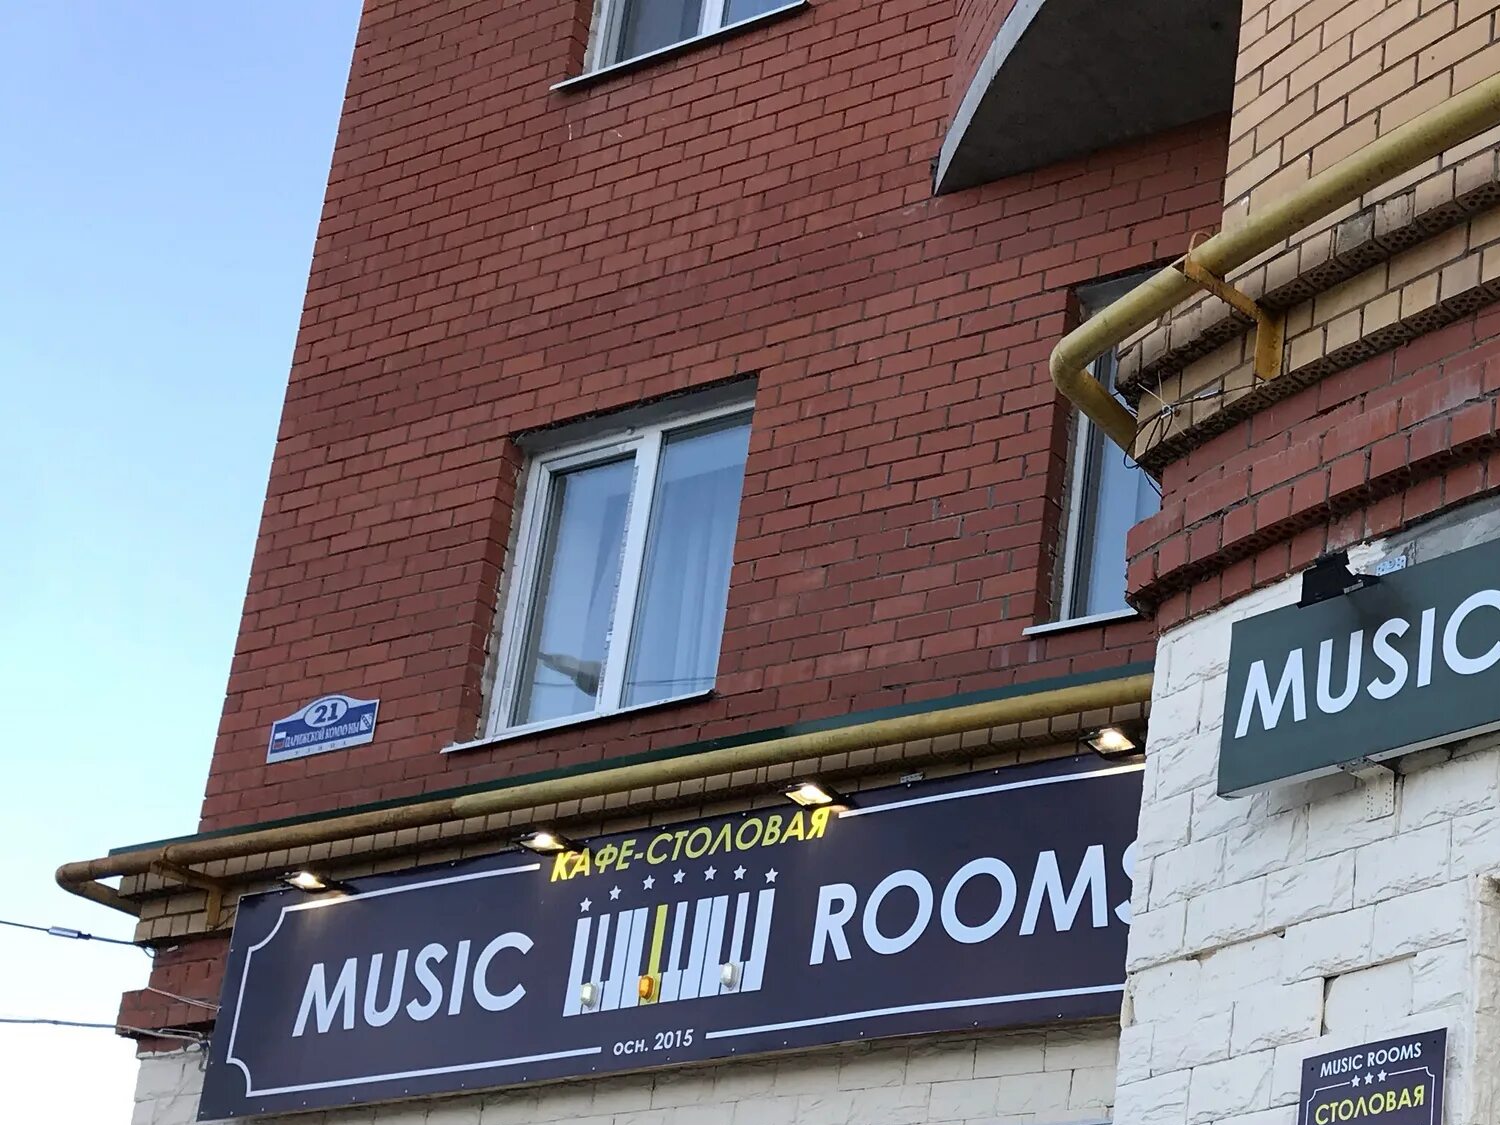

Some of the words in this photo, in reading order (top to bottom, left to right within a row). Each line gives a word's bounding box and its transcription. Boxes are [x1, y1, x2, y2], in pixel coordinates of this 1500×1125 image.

[312, 702, 338, 725] 21
[550, 807, 831, 882] КАФЕ-СТОЛОВАЯ
[291, 930, 536, 1038] MUSIC
[614, 1039, 649, 1056] осн.
[654, 1029, 694, 1050] 2015
[1320, 1053, 1364, 1078] MUSIC
[1367, 1042, 1422, 1068] ROOMS
[1315, 1085, 1425, 1125] СТОЛОВАЯ
